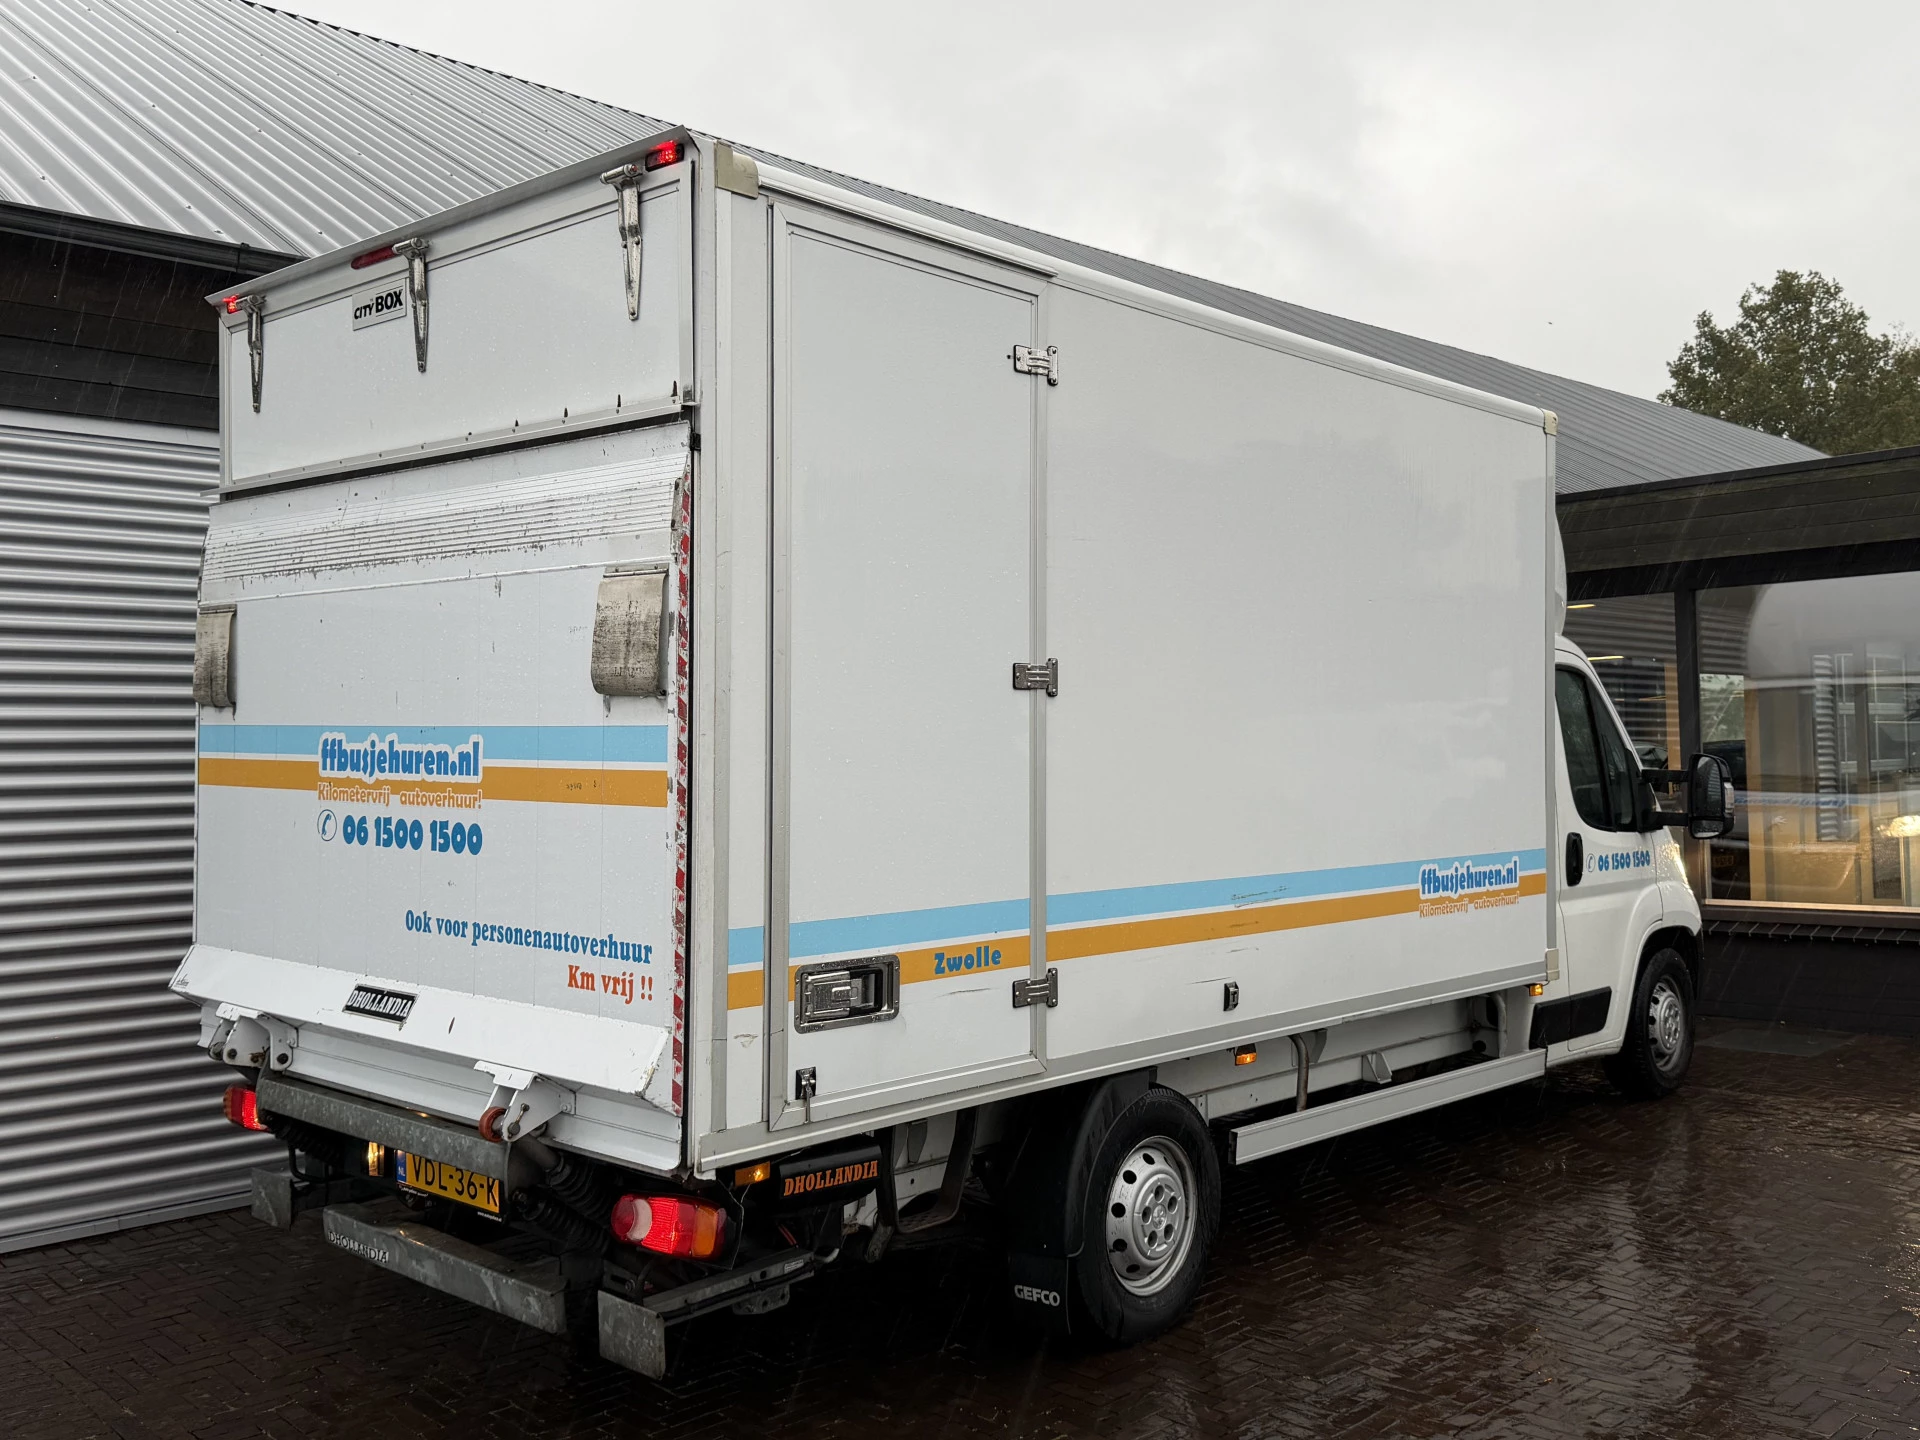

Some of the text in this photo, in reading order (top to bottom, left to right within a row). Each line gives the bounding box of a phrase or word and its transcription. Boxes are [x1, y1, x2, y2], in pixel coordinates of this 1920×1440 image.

[354, 289, 403, 319] CITY BOX
[321, 738, 480, 777] ffbusjehuren.nl
[318, 782, 482, 809] Kilometervrij autoverhuur!
[343, 815, 483, 855] 06 1500 1500
[1598, 850, 1651, 871] 06 1500 1500
[1421, 860, 1518, 894] ffbusjehuren.nl
[1419, 890, 1520, 918] Kilometervrij autoverhuur!
[405, 910, 653, 964] Ook voor personenautoverhuur
[934, 946, 1002, 974] Zwolle
[567, 965, 596, 991] Km
[601, 971, 634, 1005] vrij
[347, 990, 412, 1017] DHOLLANDIA
[412, 1154, 498, 1207] VDL-36-K
[783, 1160, 878, 1197] DHOLLANDIA
[328, 1231, 389, 1263] DHOLLANDIA
[1014, 1284, 1061, 1307] GEFCO
